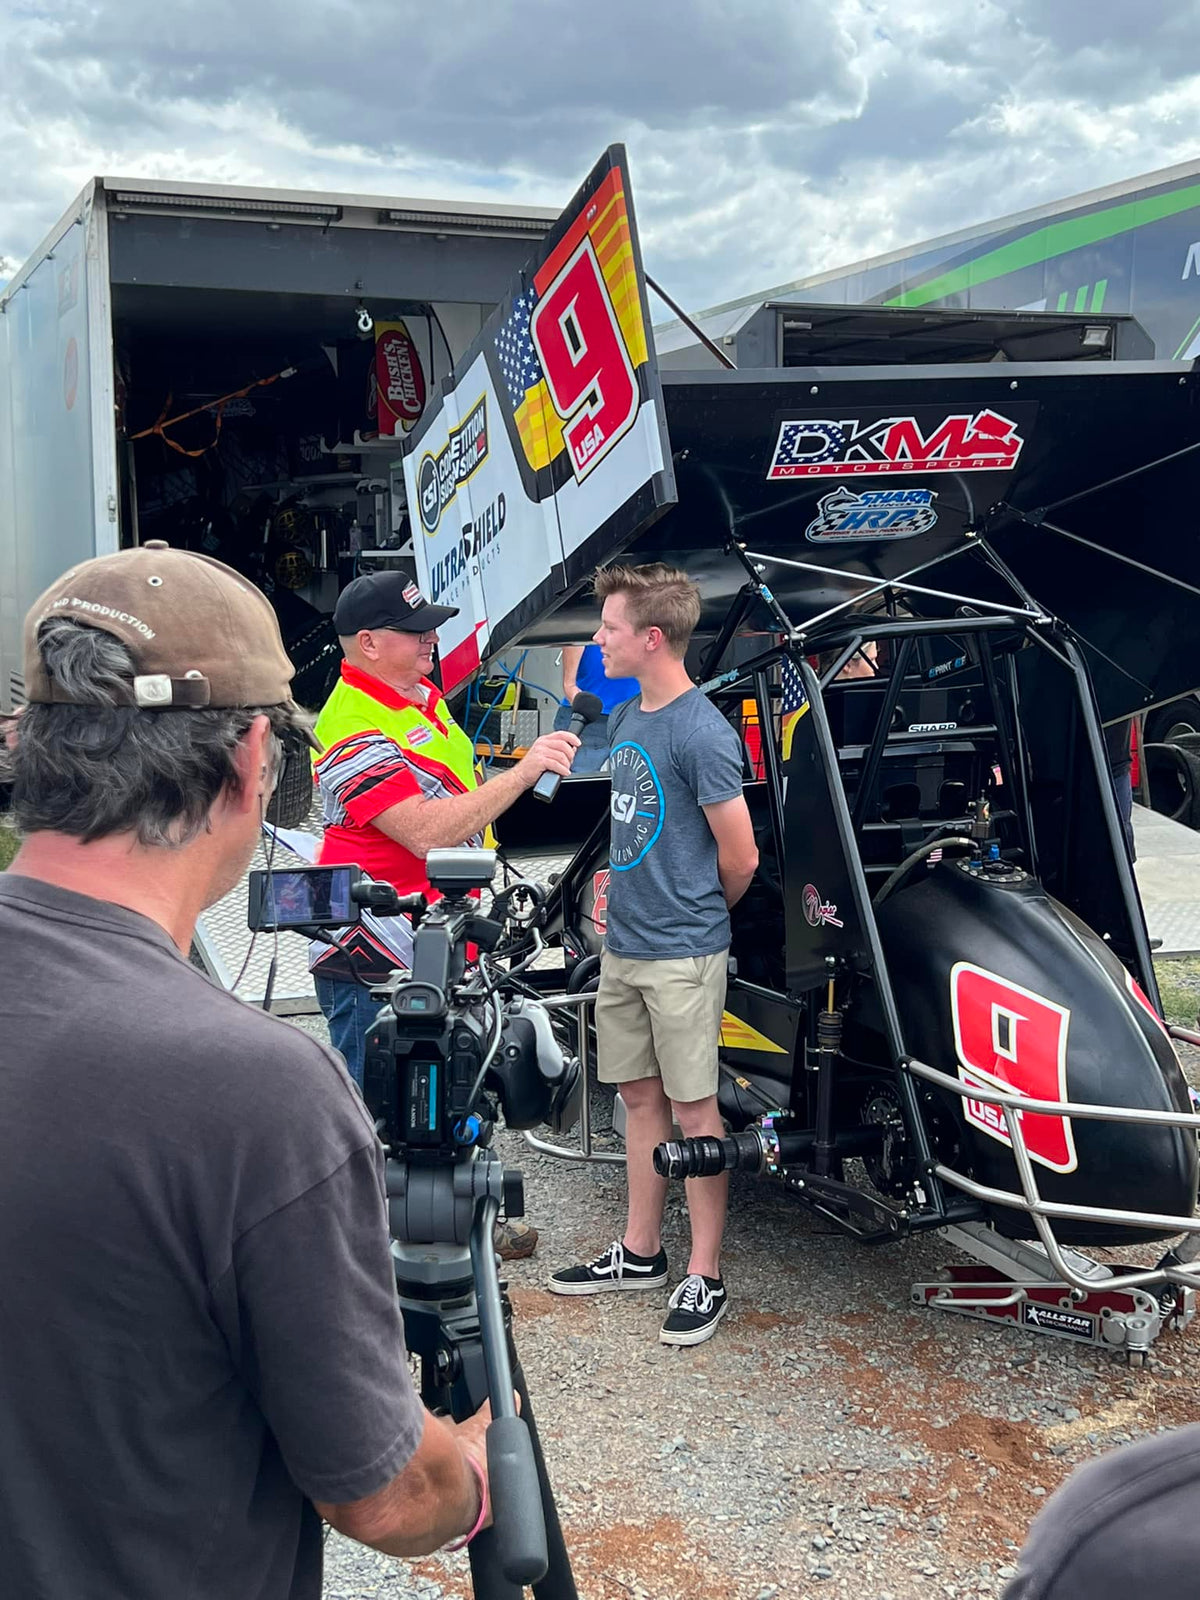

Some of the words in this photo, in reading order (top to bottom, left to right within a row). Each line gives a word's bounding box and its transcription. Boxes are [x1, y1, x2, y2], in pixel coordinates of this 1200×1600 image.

[383, 343, 404, 400] BUSH'S
[392, 338, 421, 412] CHICKEN!
[529, 232, 640, 486] 9
[440, 406, 485, 482] COETITION
[574, 422, 605, 466] USA
[774, 415, 975, 465] DKM
[779, 458, 1006, 475] MOTORSPORT
[835, 509, 919, 531] HRP
[849, 490, 932, 507] SHARK
[432, 491, 506, 603] ULTRASHIELD
[461, 542, 501, 588] PRDUCTS
[71, 597, 156, 640] PRODUCTION
[951, 961, 1078, 1174] 9
[1038, 1310, 1091, 1328] ALLSTAR
